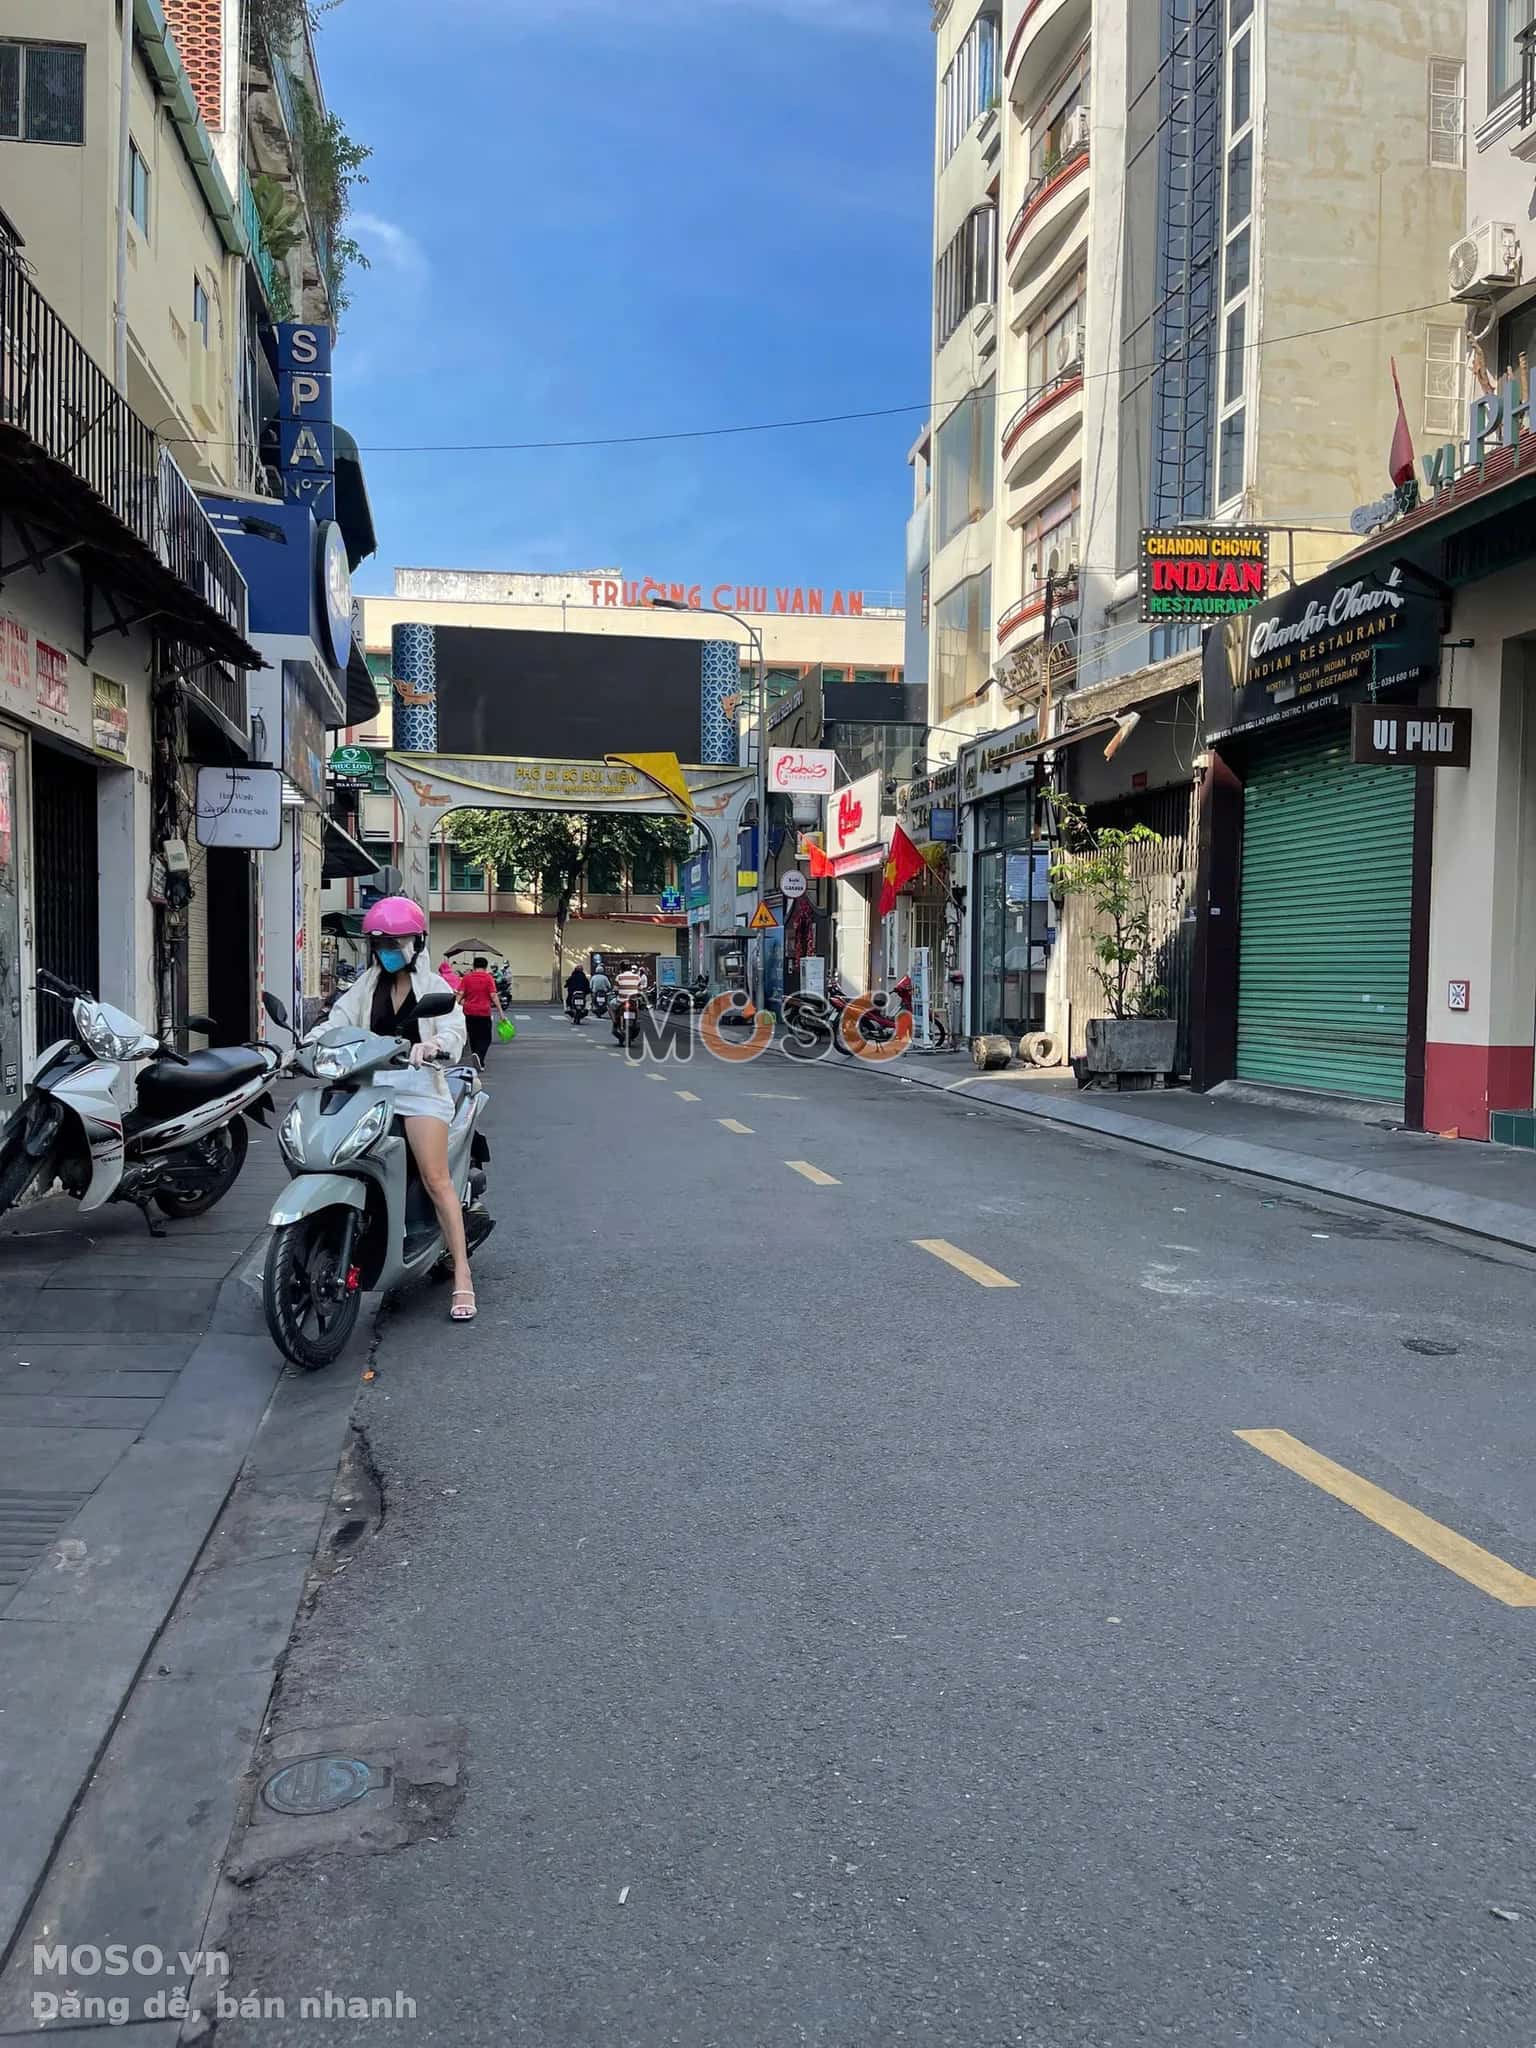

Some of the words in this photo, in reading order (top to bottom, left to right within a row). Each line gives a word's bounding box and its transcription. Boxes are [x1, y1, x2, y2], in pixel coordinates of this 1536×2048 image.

[289, 329, 326, 467] SPA
[1147, 537, 1208, 556] CHANDNI
[1210, 539, 1262, 557] CHOWK
[1151, 560, 1263, 593] INDIAN
[711, 584, 767, 613] CHU
[831, 590, 864, 617] AN
[1249, 654, 1292, 681] INDIAN
[1300, 613, 1397, 662] RESTAURANT
[1298, 664, 1320, 682] SOUTH
[1323, 658, 1346, 675] INDIAN
[1350, 649, 1371, 666] FOOD
[1316, 668, 1358, 689] VEGETARIAN
[1405, 714, 1456, 752] PHỞ
